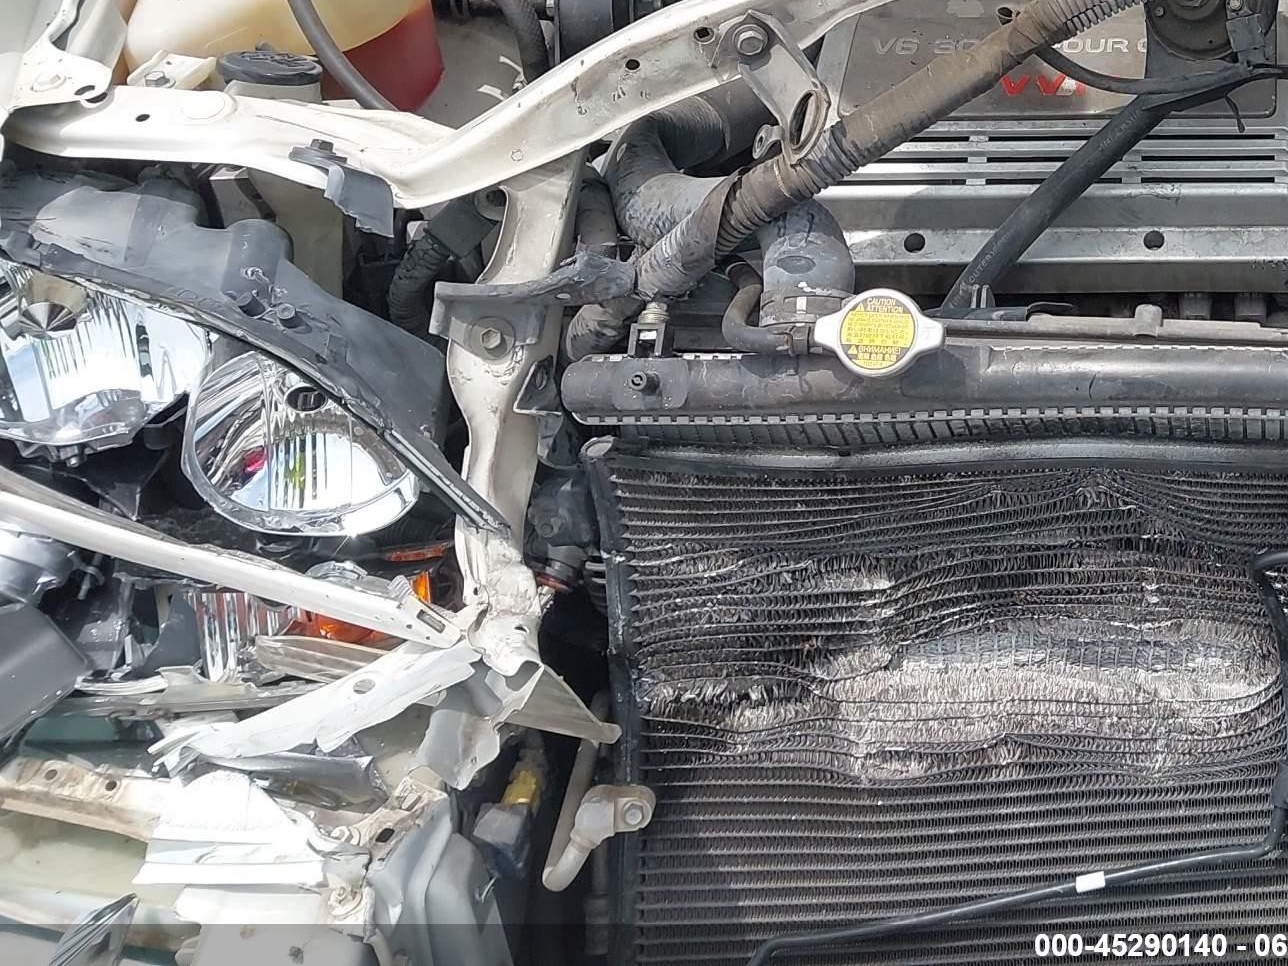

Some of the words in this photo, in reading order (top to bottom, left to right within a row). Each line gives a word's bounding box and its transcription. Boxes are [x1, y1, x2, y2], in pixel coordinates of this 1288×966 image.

[873, 37, 919, 55] V6
[1061, 37, 1130, 54] OUR
[866, 297, 897, 307] CAUTION
[866, 305, 905, 314] ATTENTION
